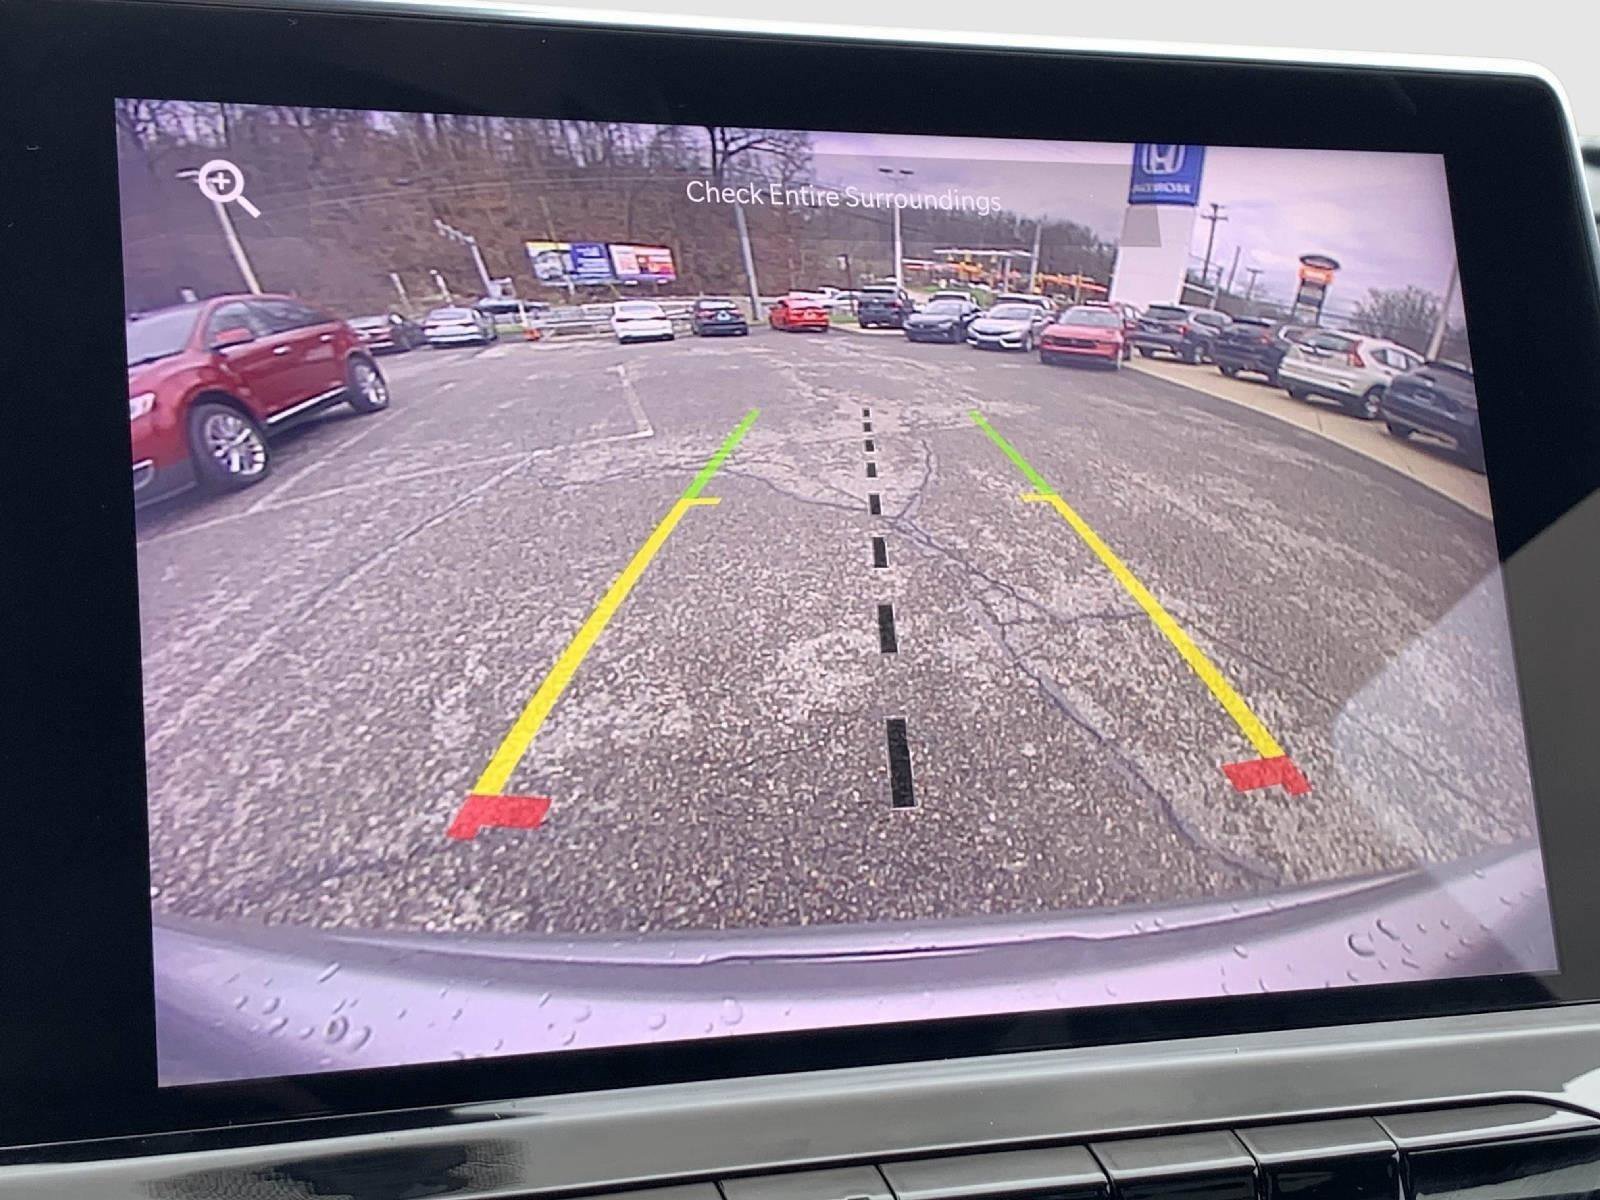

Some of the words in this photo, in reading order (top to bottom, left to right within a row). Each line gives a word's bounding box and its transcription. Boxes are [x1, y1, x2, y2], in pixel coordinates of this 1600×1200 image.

[686, 180, 764, 204] Check
[770, 183, 840, 207] Entire
[845, 186, 1001, 216] Surroundings
